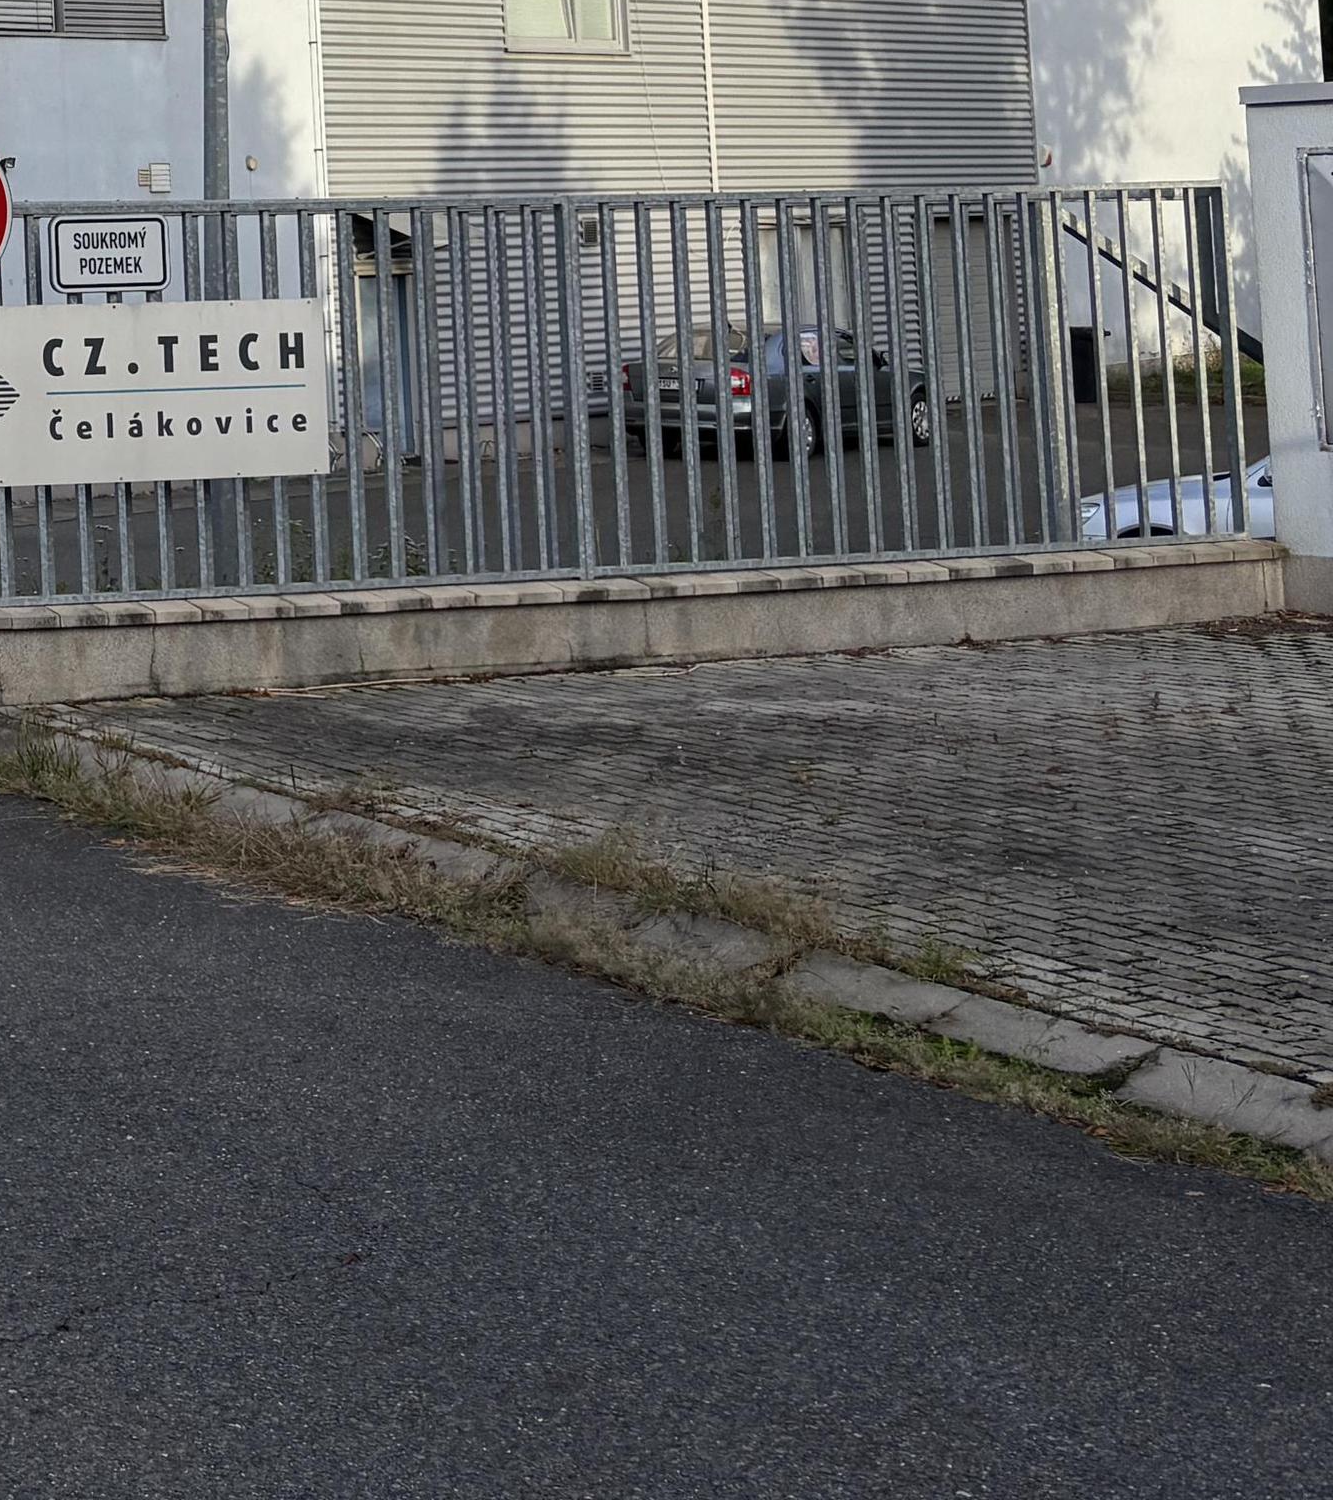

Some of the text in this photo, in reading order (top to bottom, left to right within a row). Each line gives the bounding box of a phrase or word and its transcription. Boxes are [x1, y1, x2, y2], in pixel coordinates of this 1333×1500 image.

[73, 227, 147, 250] SOUKROMÝ
[79, 256, 143, 276] POZEMEK
[42, 332, 305, 377] CZ.TECH
[49, 408, 307, 441] Čelákovice
